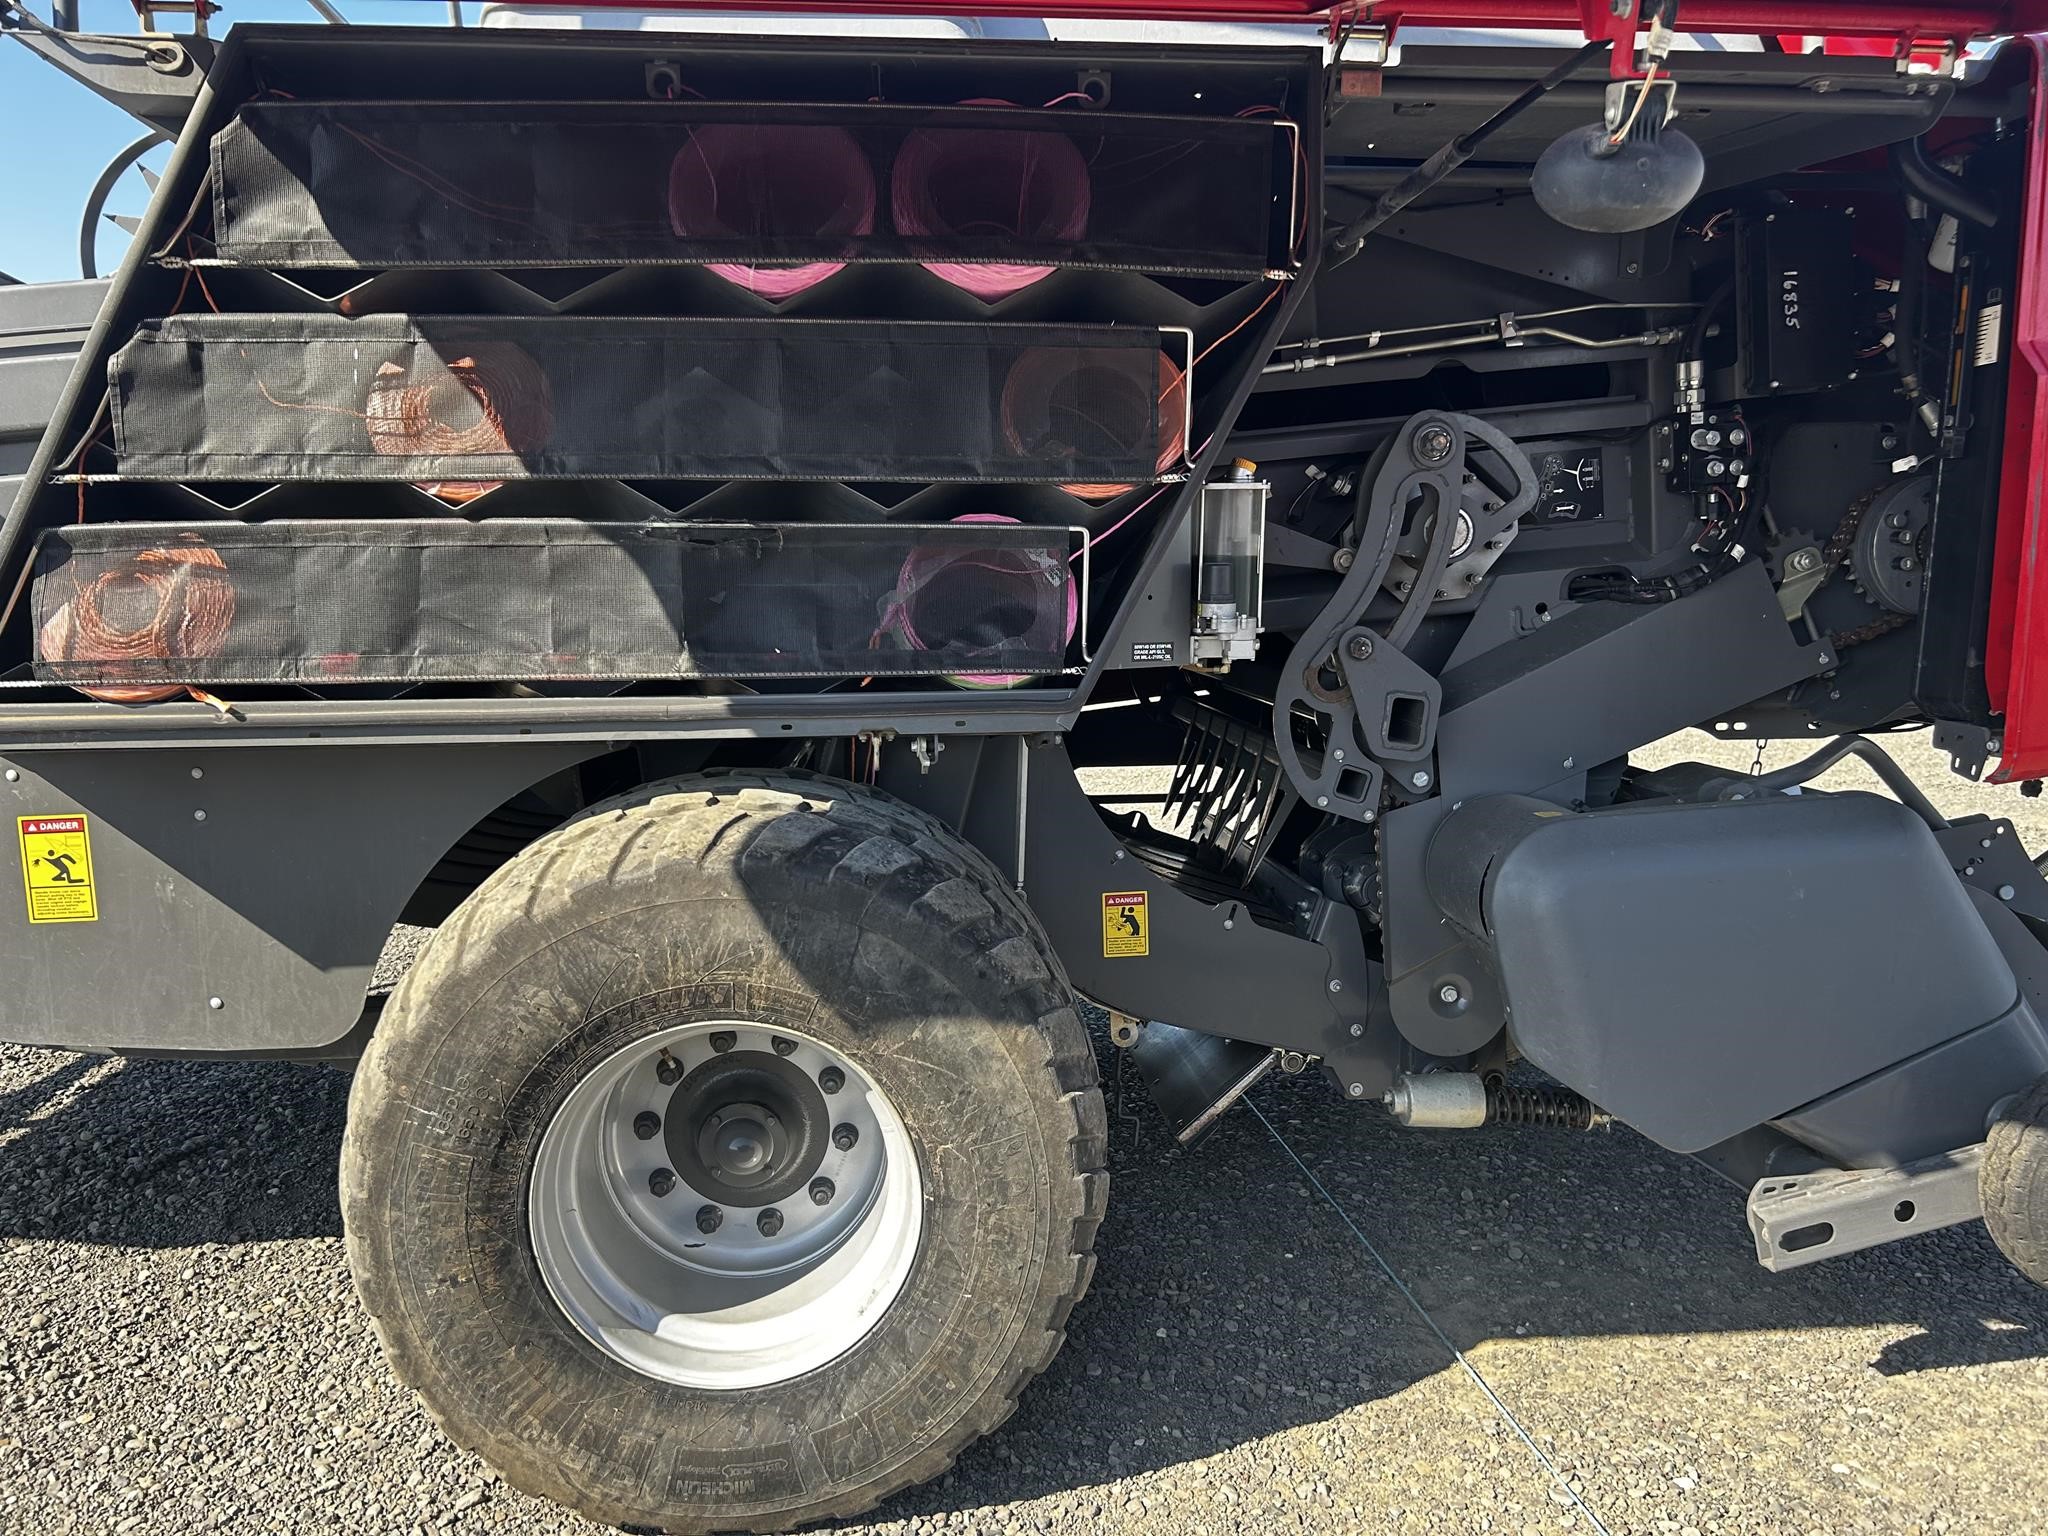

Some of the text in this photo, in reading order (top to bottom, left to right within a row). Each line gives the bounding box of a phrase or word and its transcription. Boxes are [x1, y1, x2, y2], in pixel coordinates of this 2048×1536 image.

[1782, 271, 1801, 329] 16835
[39, 821, 79, 831] DANGER
[1115, 896, 1143, 904] DANGER
[675, 1479, 756, 1496] MICHELIN
